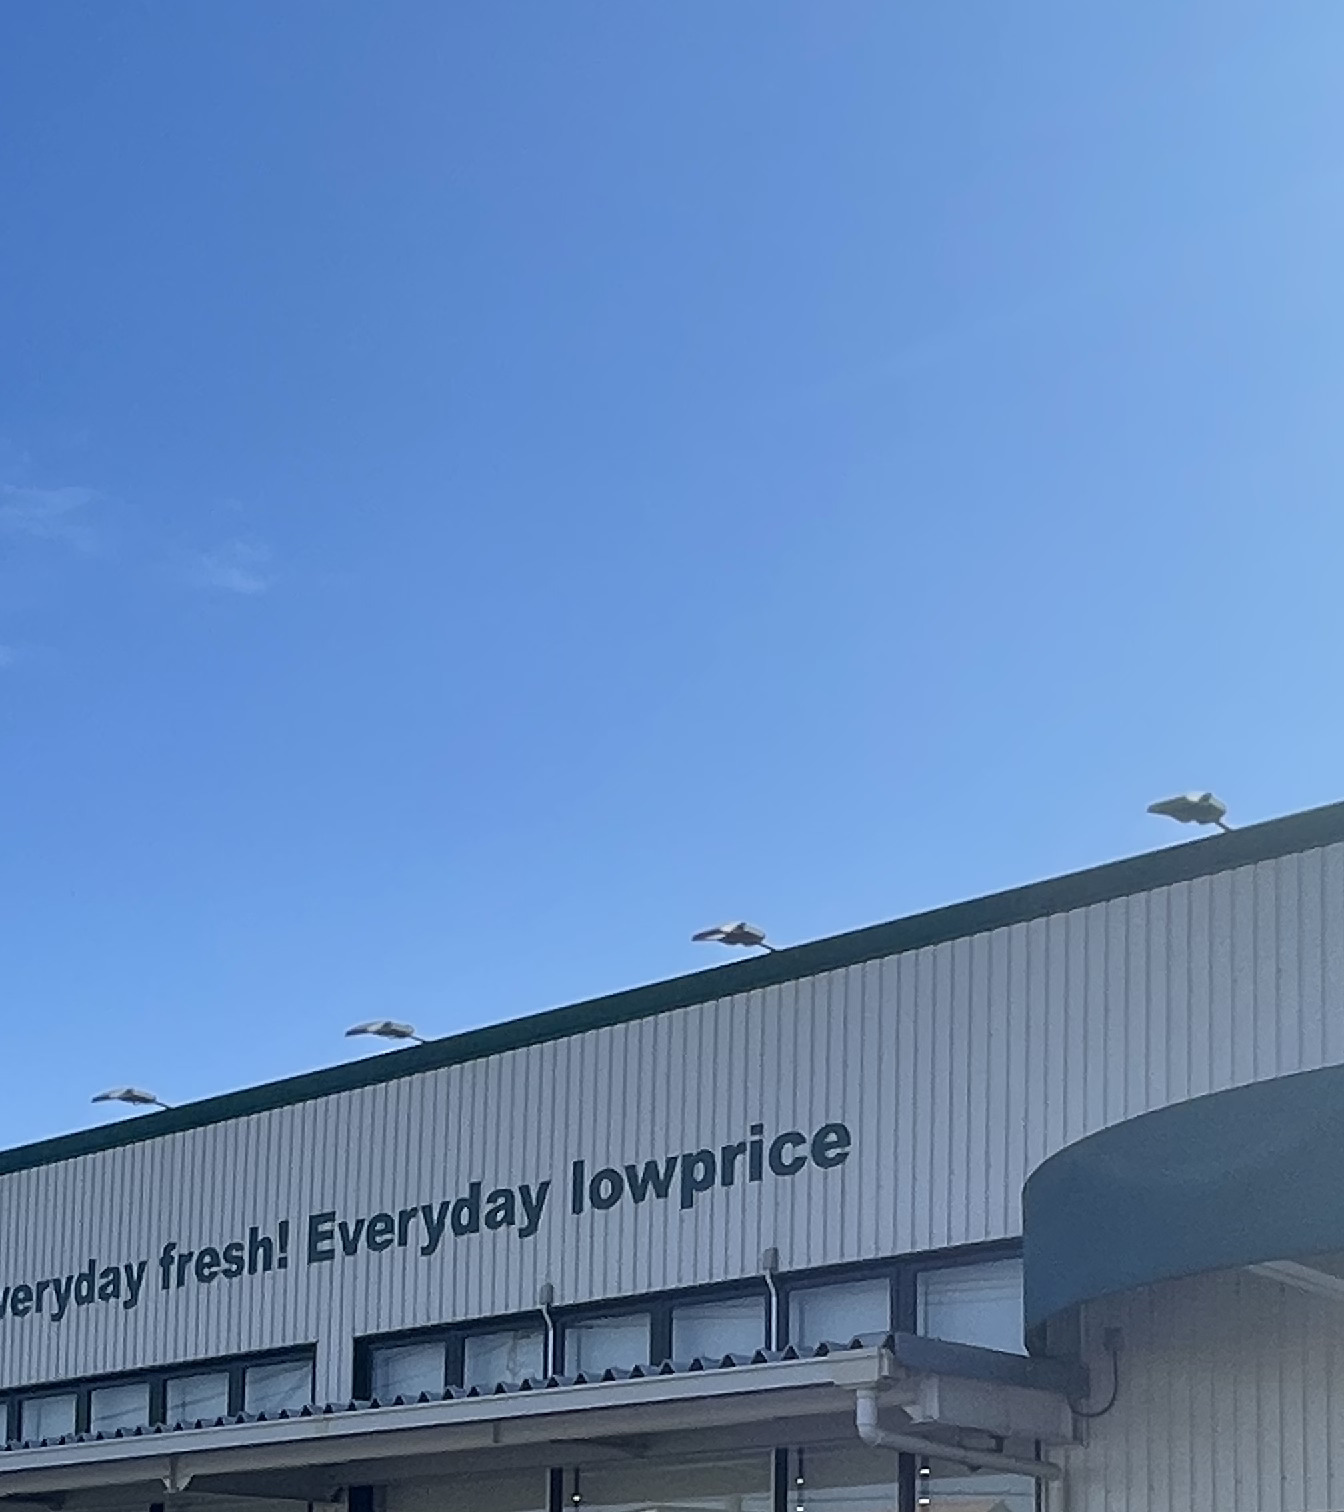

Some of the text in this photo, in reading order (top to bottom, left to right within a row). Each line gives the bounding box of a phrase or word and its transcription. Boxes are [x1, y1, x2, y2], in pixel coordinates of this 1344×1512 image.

[159, 1219, 289, 1290] fresh!
[308, 1179, 550, 1265] Everyday
[571, 1121, 851, 1214] lowprice
